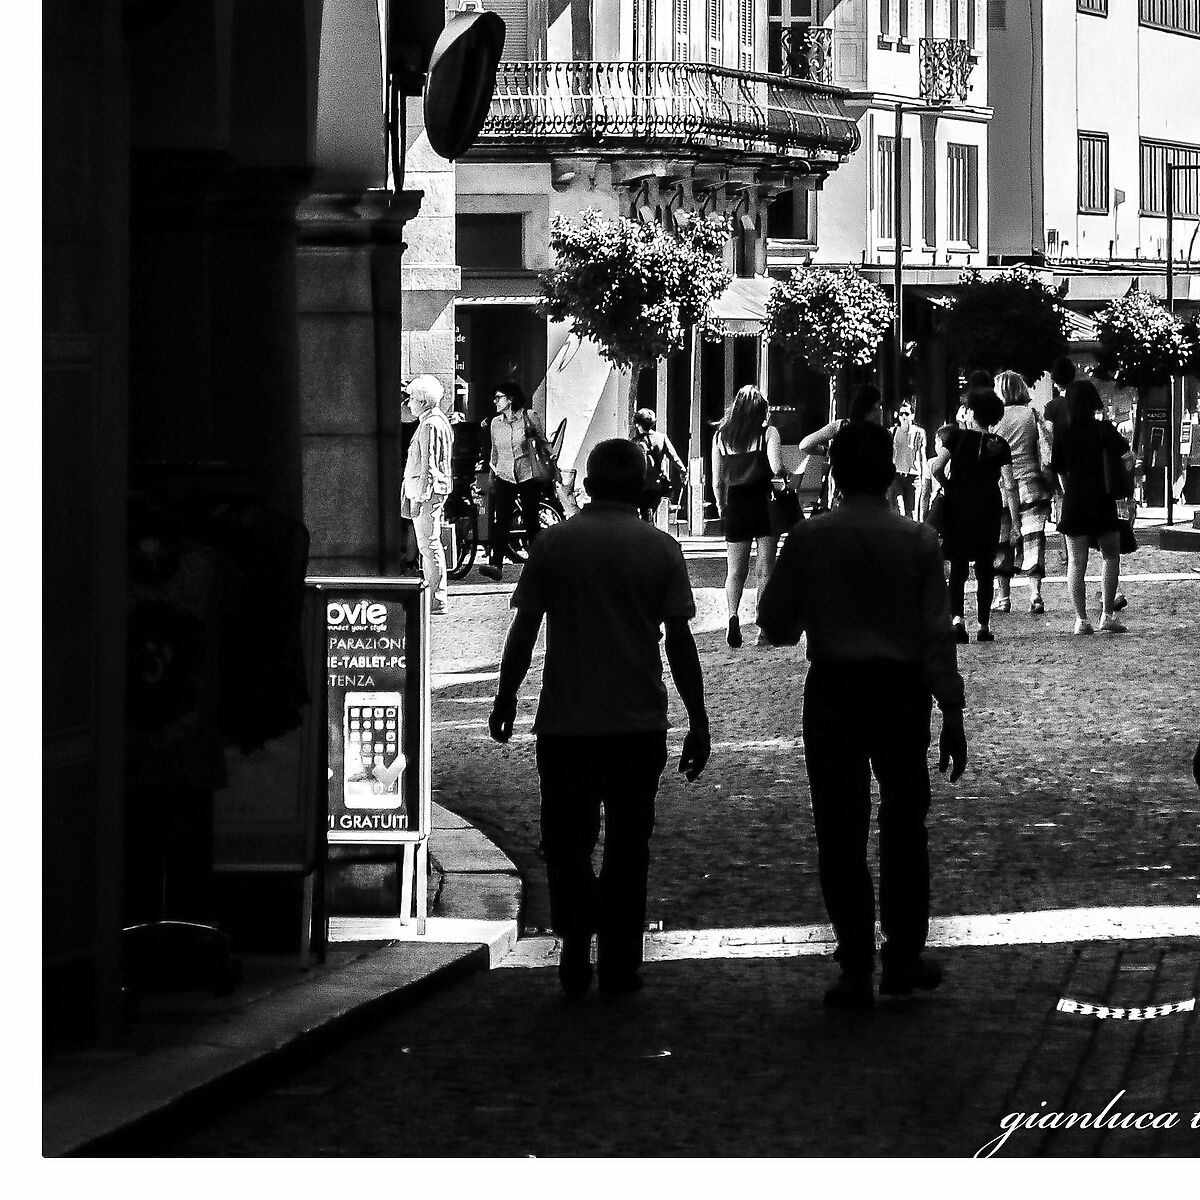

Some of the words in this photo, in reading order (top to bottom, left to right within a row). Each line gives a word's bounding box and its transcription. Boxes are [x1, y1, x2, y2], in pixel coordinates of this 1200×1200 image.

[351, 625, 369, 633] your
[370, 624, 387, 633] style
[327, 674, 376, 687] TENZA
[340, 814, 409, 829] GRATUITI
